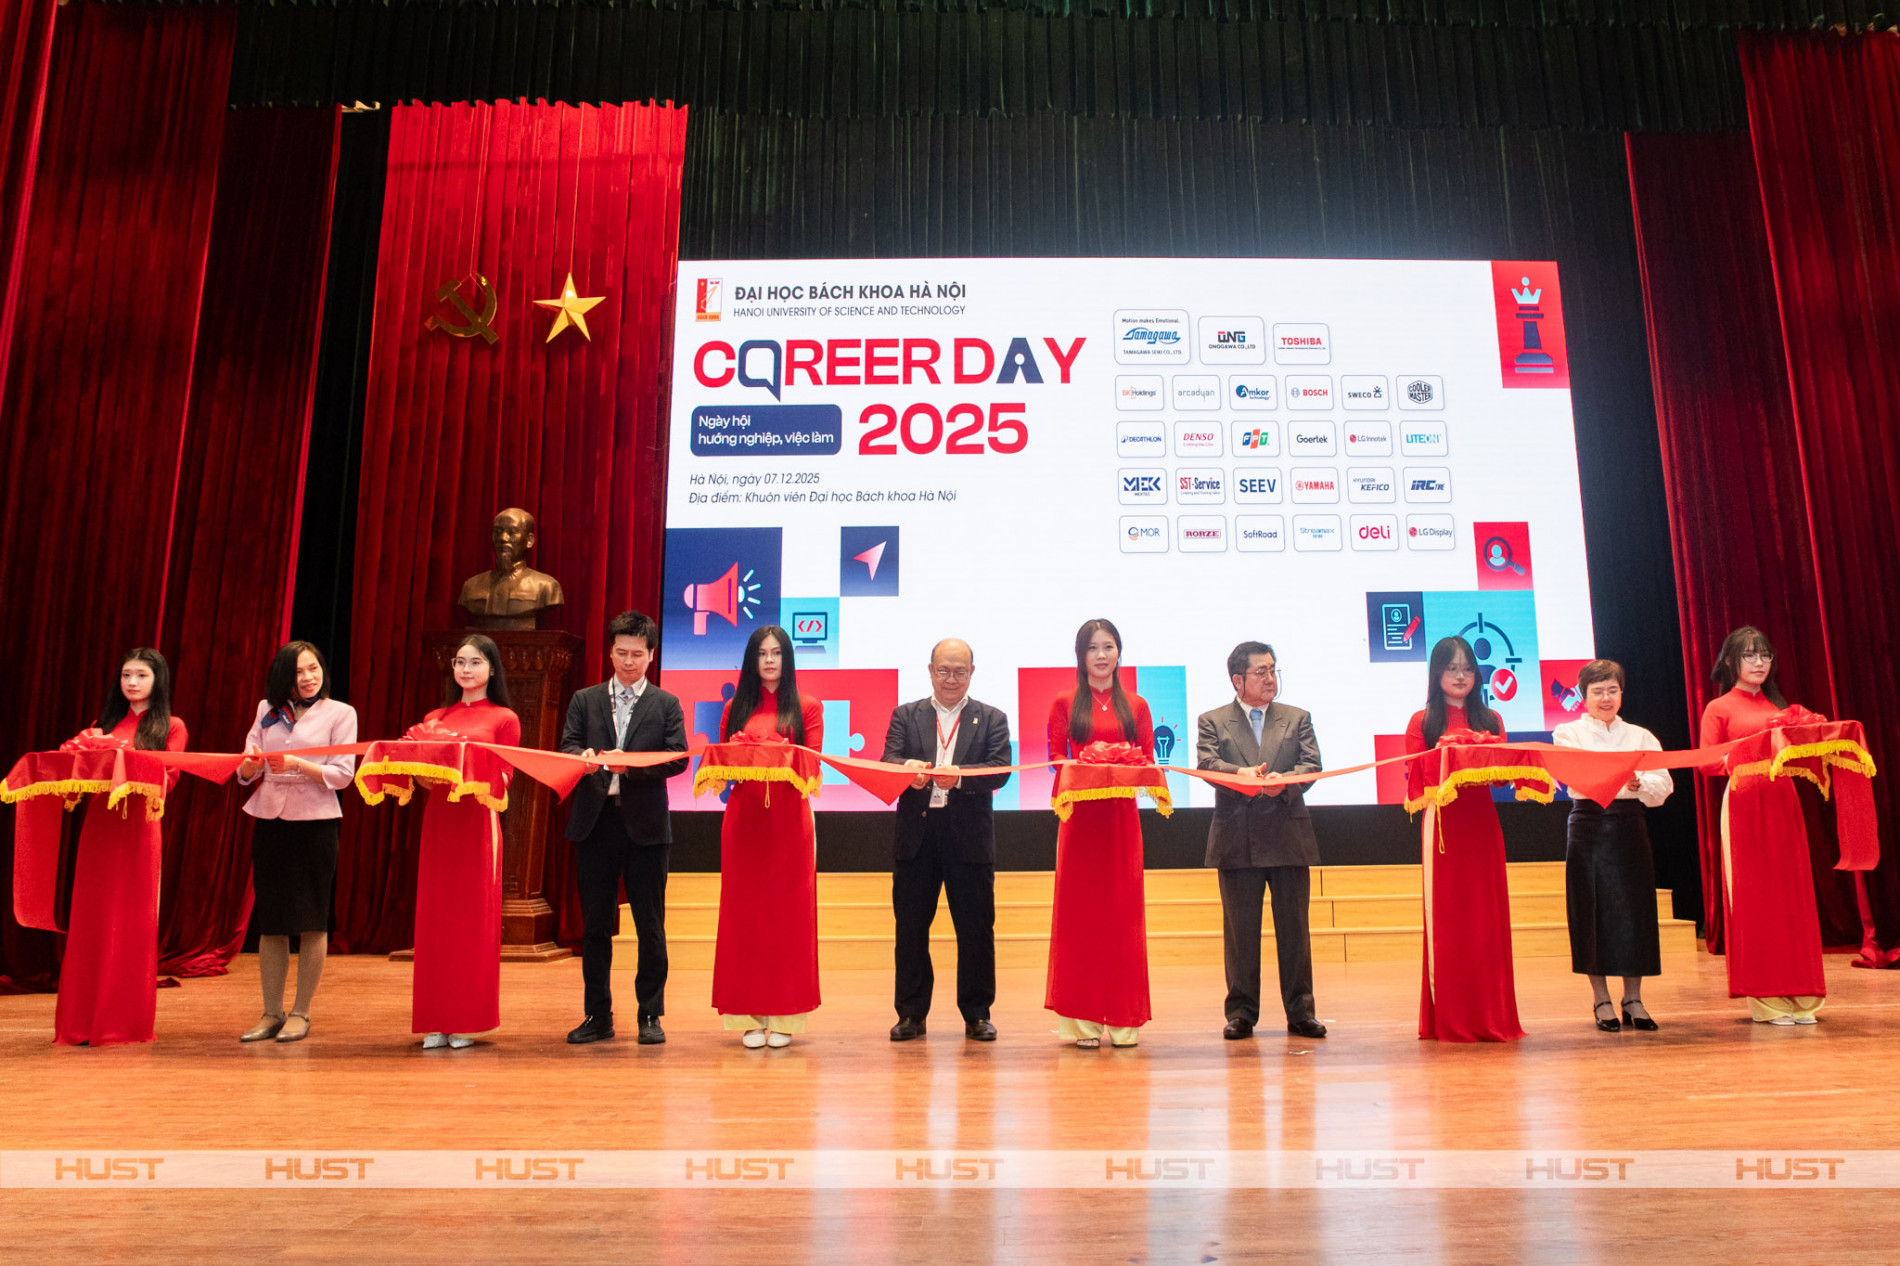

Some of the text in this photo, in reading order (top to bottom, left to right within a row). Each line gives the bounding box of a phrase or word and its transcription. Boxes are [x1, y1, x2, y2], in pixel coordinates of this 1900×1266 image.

[734, 280, 966, 304] ĐẠI HỌC BÁCH KHOA HÀ NỘI
[733, 305, 966, 317] HANOI UNIVERSITY OF SCIENCE AND TECHNOLOGY
[1122, 327, 1181, 344] Tamagawa
[1281, 337, 1322, 346] TOSHIBA
[953, 337, 1088, 384] DAY
[1178, 384, 1215, 402] arcadyan
[1236, 385, 1270, 398] Amkor
[1302, 389, 1328, 397] BOSCH
[1408, 383, 1431, 393] COOLER
[1409, 391, 1433, 402] MASTER
[699, 415, 751, 430] Ngày hội
[858, 402, 1029, 455] 2025
[698, 431, 834, 447] hướng nghiệp, việc làm
[1183, 433, 1214, 441] DENSO
[1242, 429, 1269, 449] FPT
[1296, 434, 1328, 444] Goertek
[689, 472, 820, 487] Hà Nội, ngày 07.12.2025
[1123, 477, 1161, 492] MEK
[1239, 479, 1276, 493] SEEV
[1304, 481, 1334, 490] YAMAHA
[689, 490, 957, 505] Địa điểm: Khuôn viên Đại học Bách khoa Hà Nội
[1140, 528, 1160, 537] MOR
[1243, 530, 1278, 539] SoftRoad
[1359, 526, 1390, 539] deli
[1419, 528, 1453, 537] LG Display
